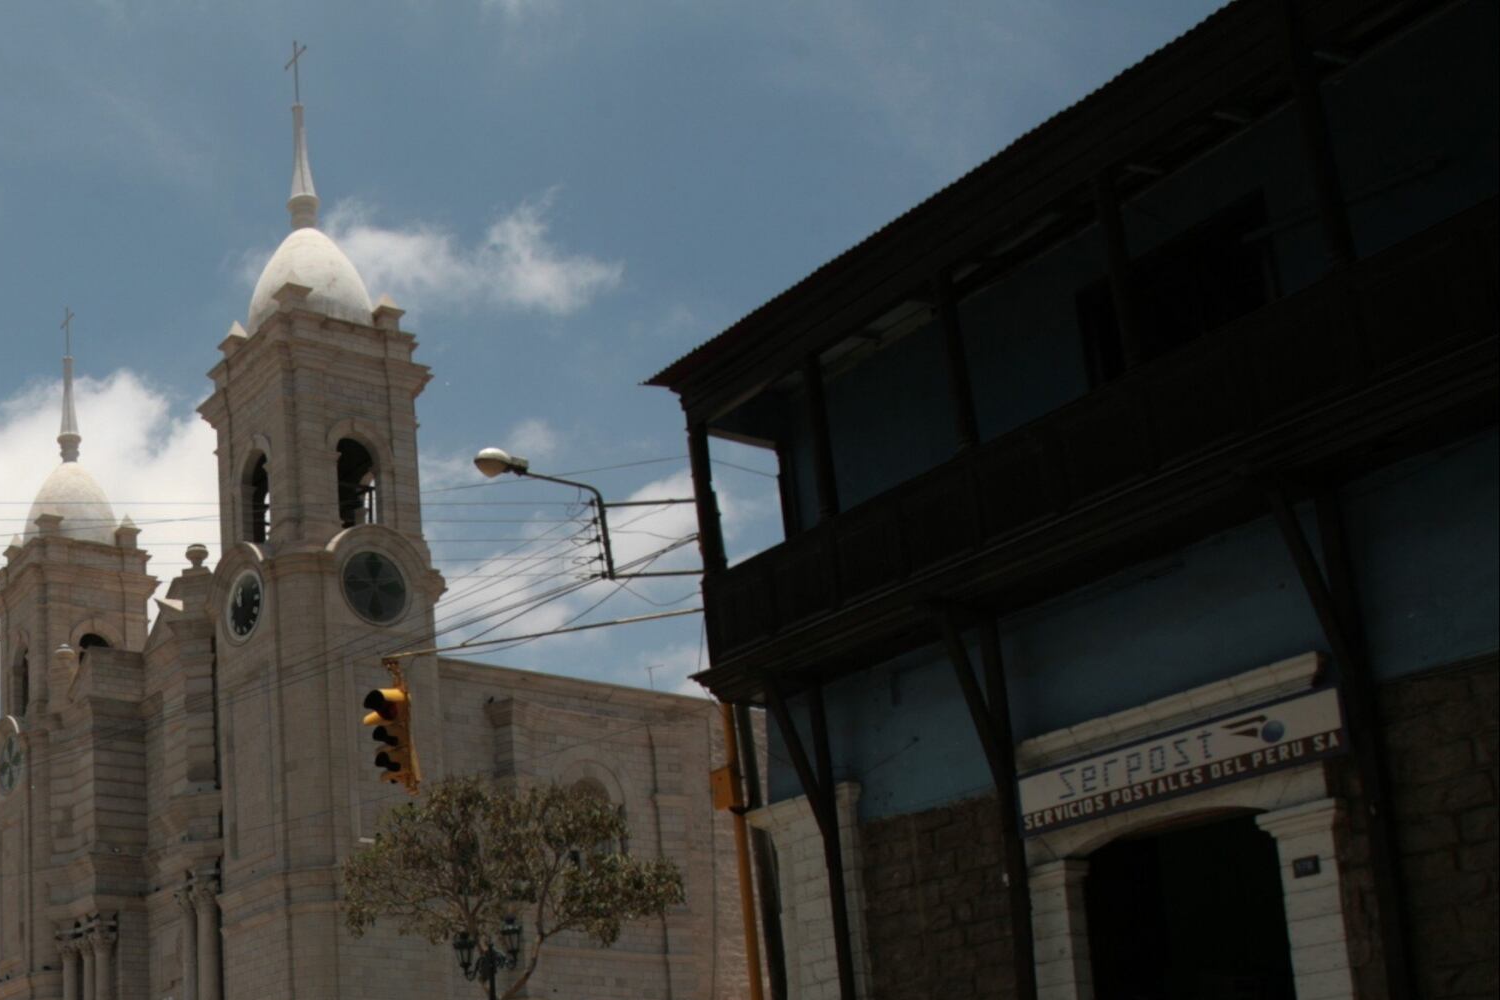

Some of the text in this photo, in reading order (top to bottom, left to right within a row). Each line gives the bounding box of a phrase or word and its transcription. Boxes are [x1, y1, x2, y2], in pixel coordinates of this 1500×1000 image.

[1023, 797, 1105, 830] SERVICIOS
[1110, 769, 1204, 807] POSTALES
[1210, 759, 1247, 779] DEL
[1252, 742, 1304, 768] PERU
